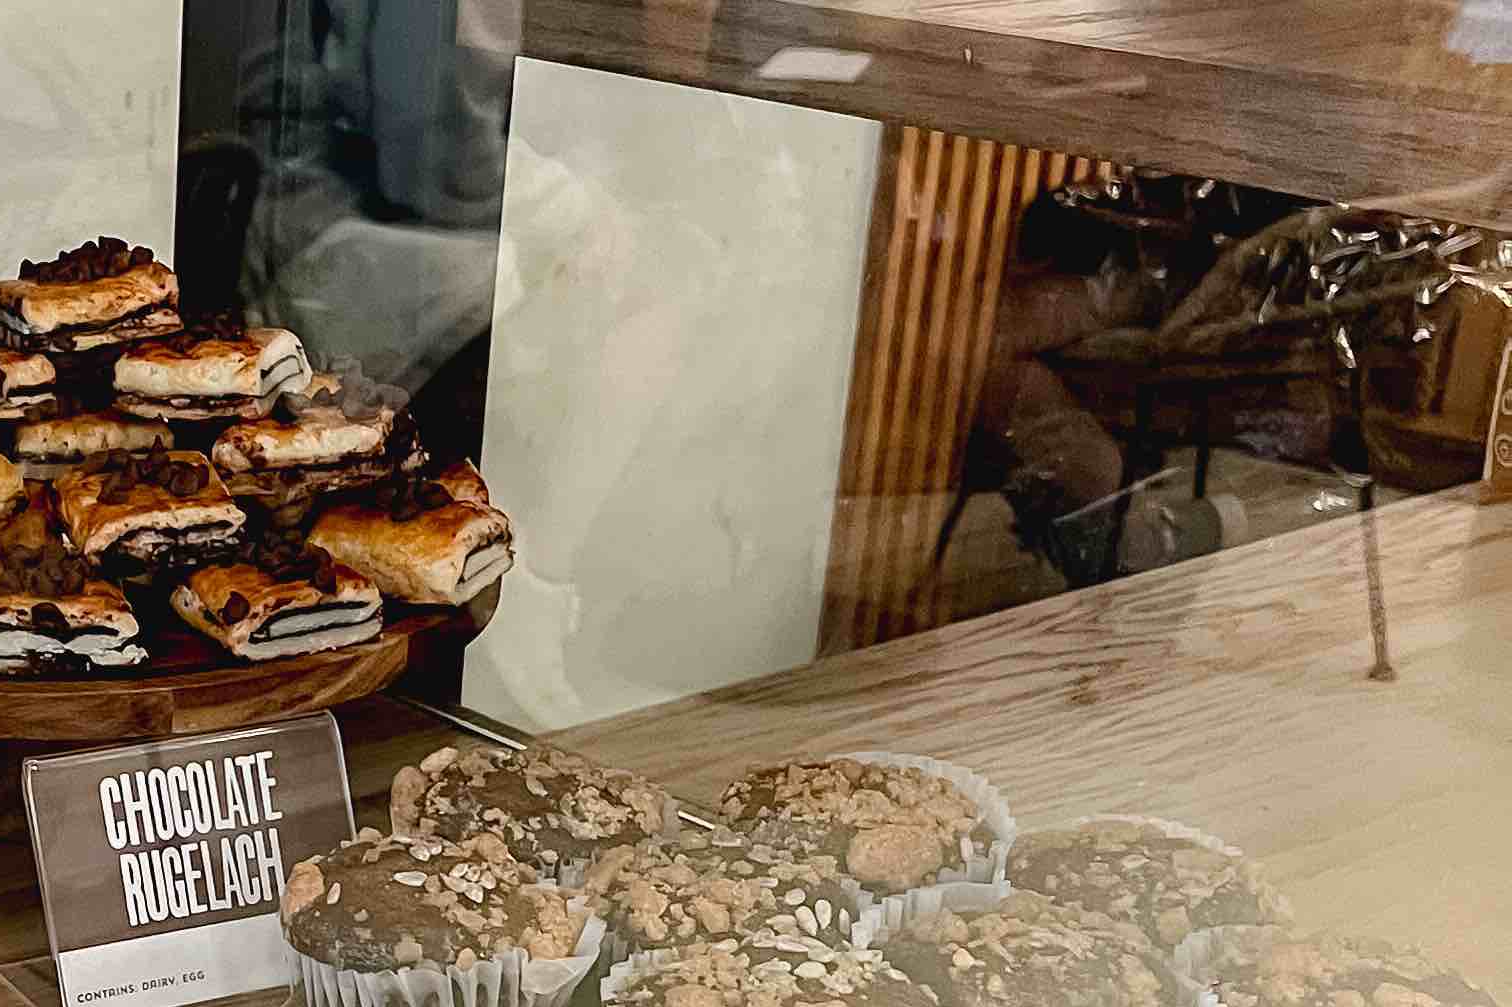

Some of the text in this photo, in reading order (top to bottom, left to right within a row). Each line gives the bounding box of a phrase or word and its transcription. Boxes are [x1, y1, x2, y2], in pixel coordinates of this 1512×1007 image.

[99, 751, 283, 849] CHOCOLATE
[119, 828, 286, 927] RUGELACH
[77, 984, 139, 1003] CONTAINS:
[182, 970, 205, 983] EGG
